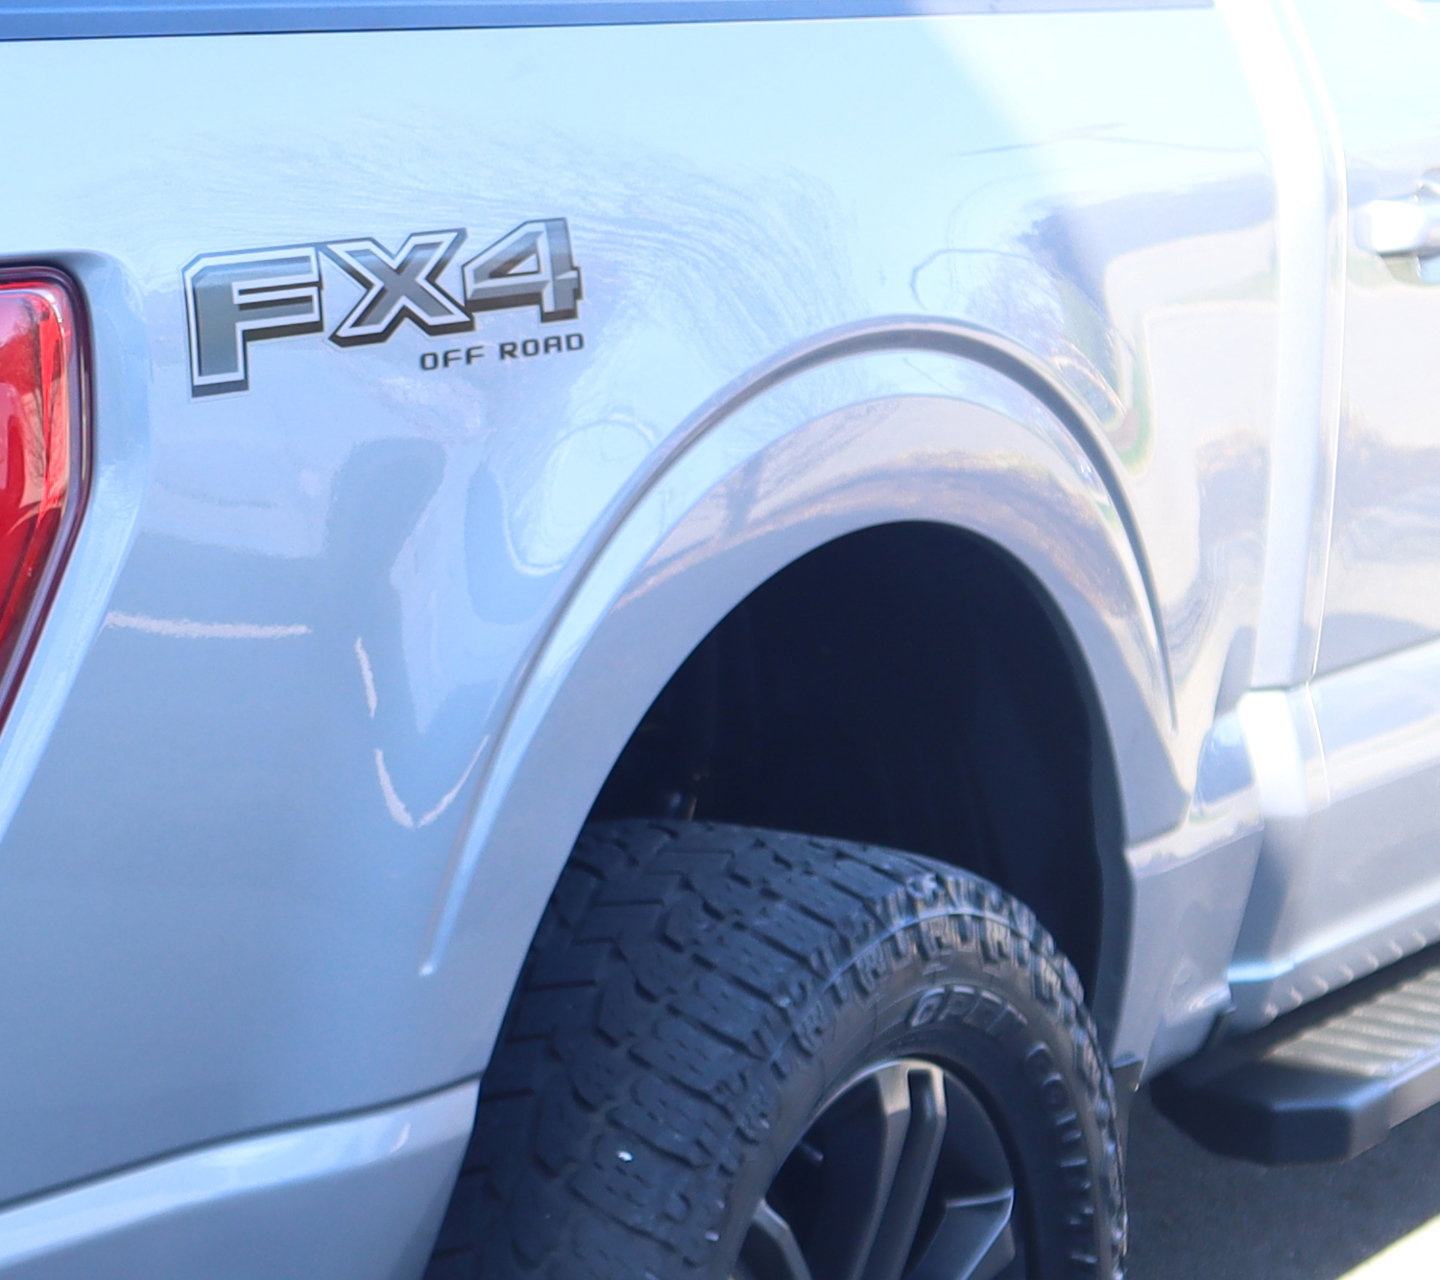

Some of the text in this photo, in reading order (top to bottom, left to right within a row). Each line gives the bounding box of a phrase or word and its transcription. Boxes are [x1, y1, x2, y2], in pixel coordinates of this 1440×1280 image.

[182, 217, 582, 398] FX4
[420, 332, 585, 371] OFF ROAD
